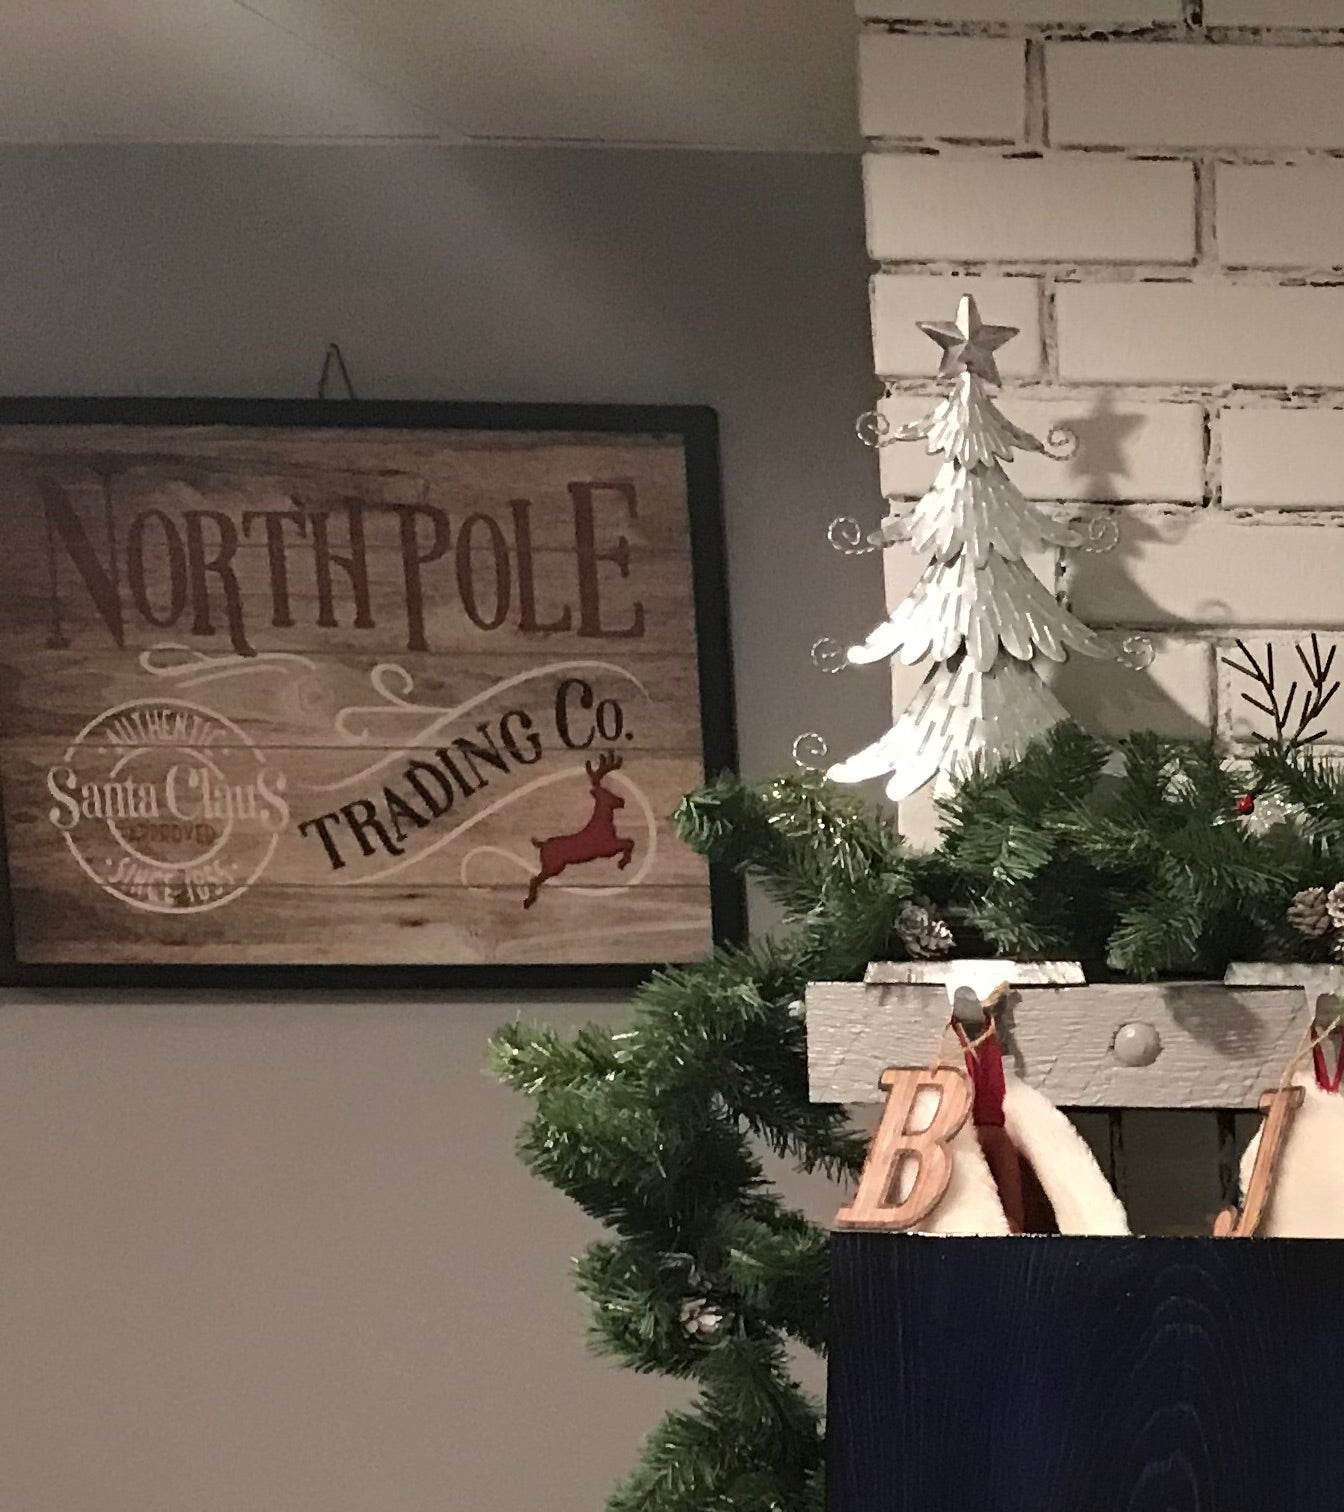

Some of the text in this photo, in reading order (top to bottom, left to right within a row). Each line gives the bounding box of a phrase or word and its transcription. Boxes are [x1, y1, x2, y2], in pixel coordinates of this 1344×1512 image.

[36, 470, 647, 657] NORTH POLE
[47, 765, 160, 829] Santa
[299, 678, 635, 871] TRADING Co.
[834, 1064, 972, 1230] B
